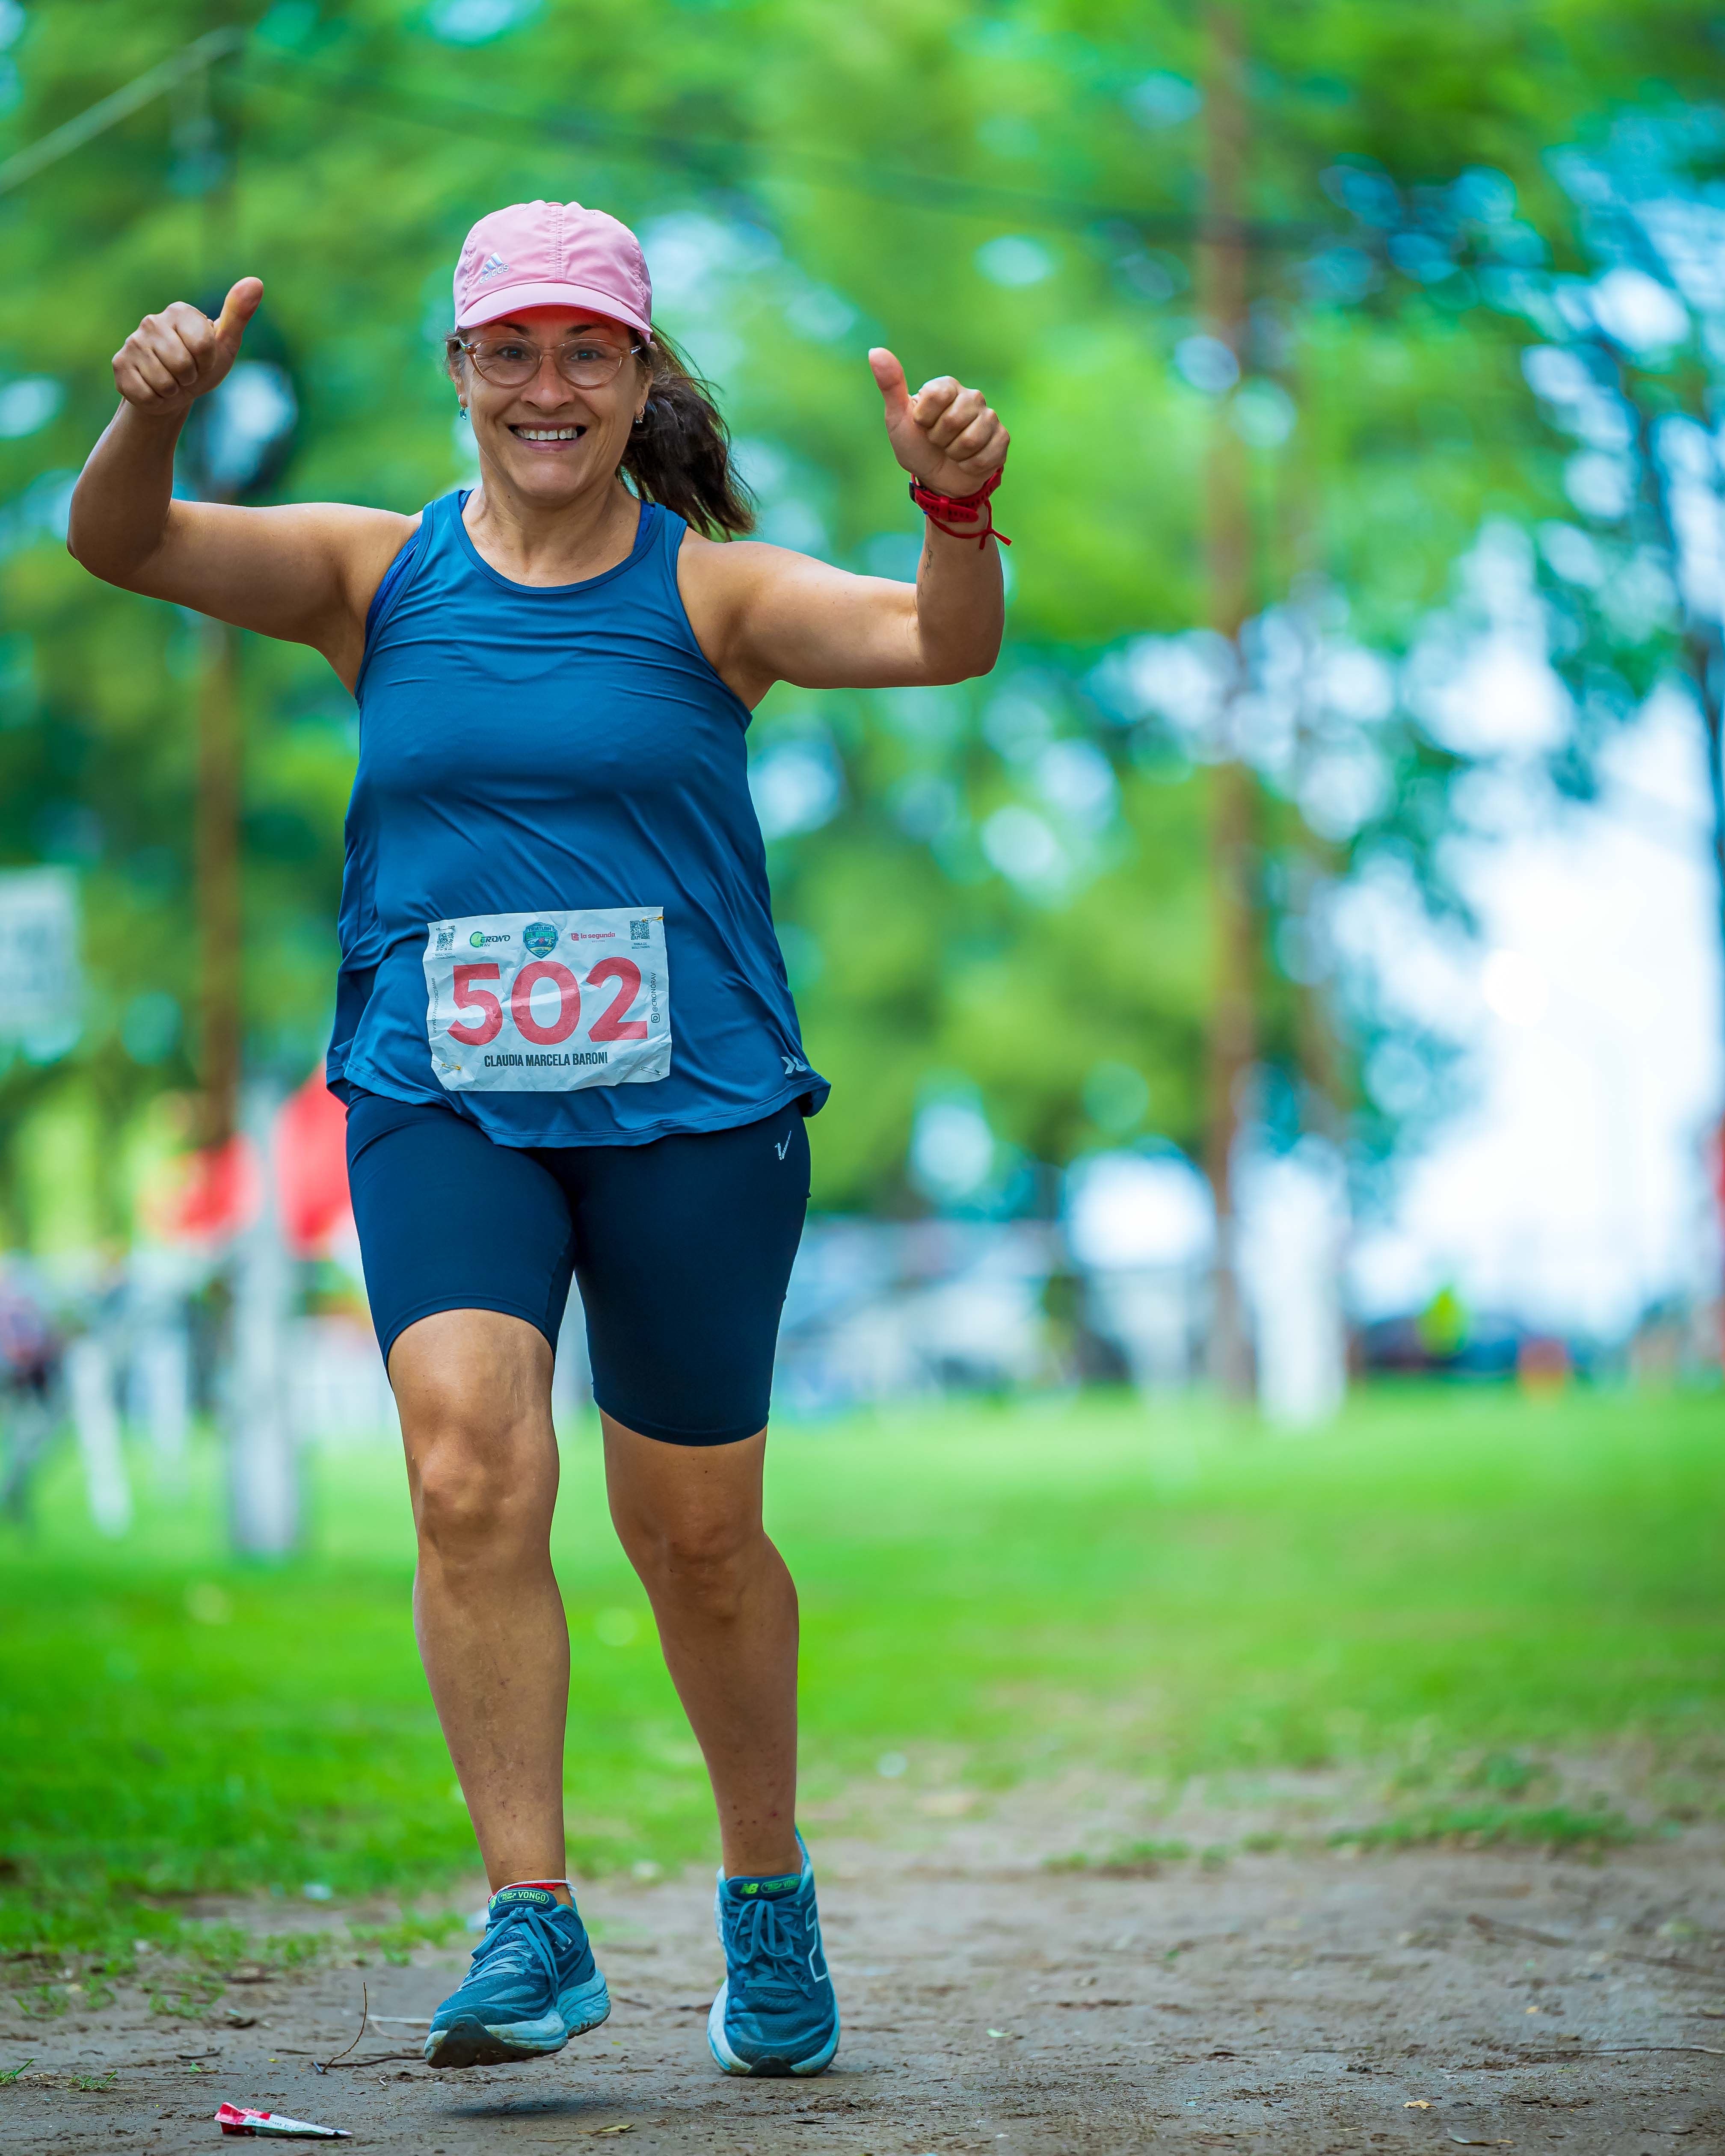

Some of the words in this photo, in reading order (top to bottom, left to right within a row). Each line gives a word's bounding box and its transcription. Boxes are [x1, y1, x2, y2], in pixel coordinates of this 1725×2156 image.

[479, 264, 509, 284] adidas
[447, 957, 648, 1046] 502
[650, 972, 658, 1012] @CRONORAV
[484, 1054, 524, 1067] CLAUDIA
[526, 1054, 570, 1066] MARCELA
[572, 1051, 608, 1065] BARONI
[518, 1891, 546, 1901] VONGO
